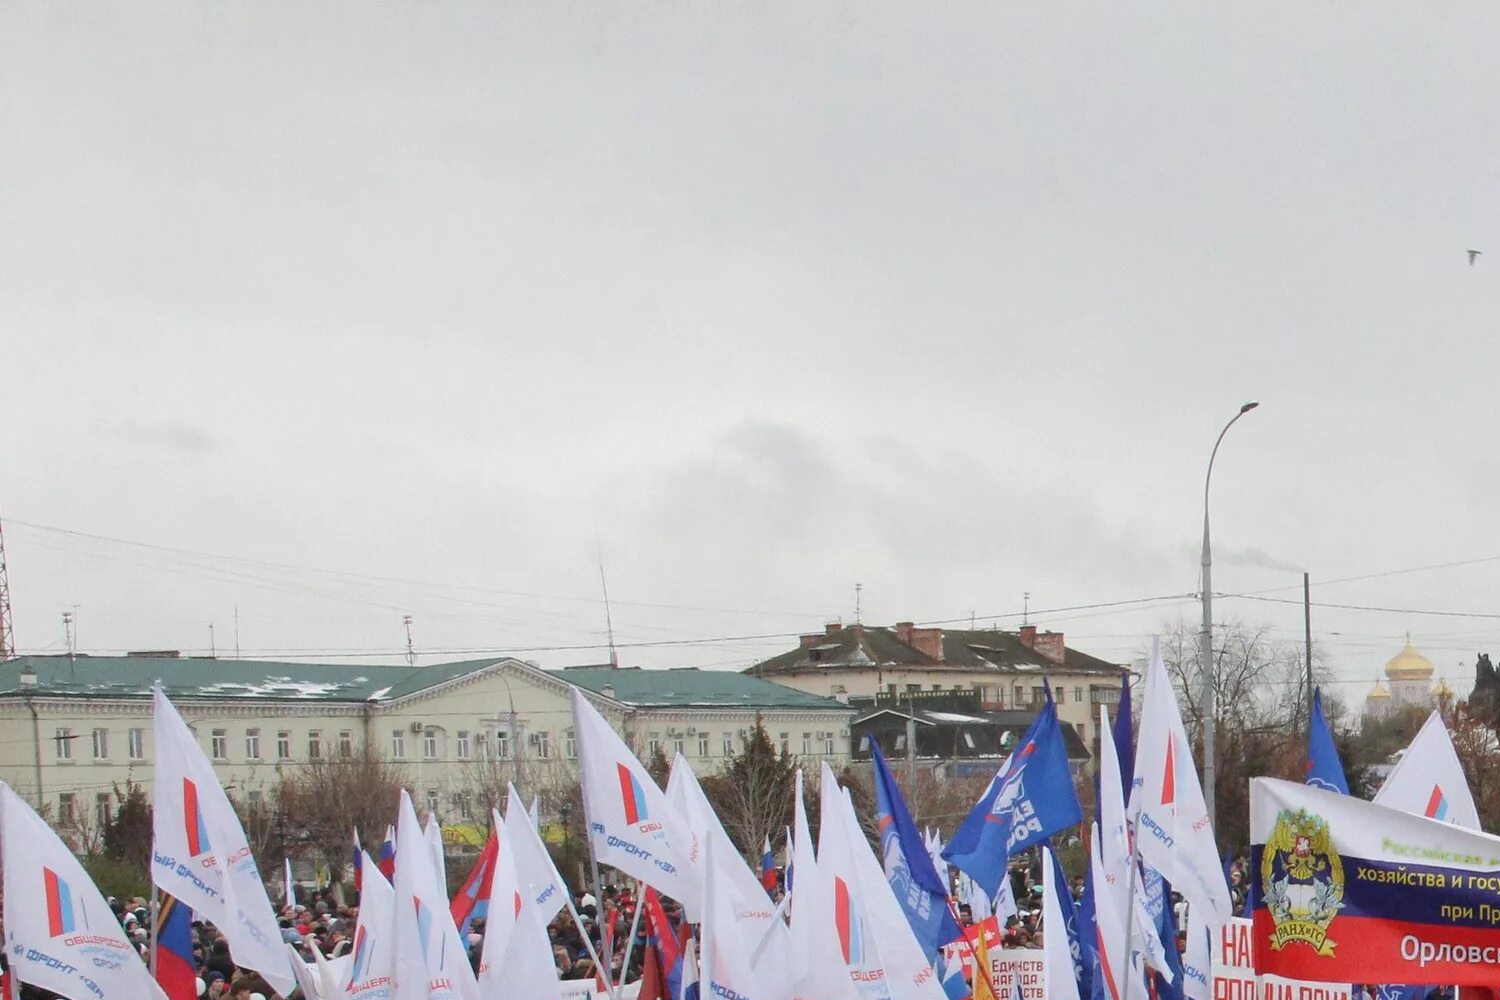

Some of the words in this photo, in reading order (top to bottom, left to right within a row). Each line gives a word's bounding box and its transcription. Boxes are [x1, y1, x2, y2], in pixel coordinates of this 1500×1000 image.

[1357, 865, 1446, 888] хозяйства
[1450, 874, 1463, 889] и
[1441, 904, 1474, 922] при
[1222, 923, 1253, 968] НА
[26, 951, 78, 975] ФРОНТ
[992, 959, 1043, 972] ЕДИНСТВ
